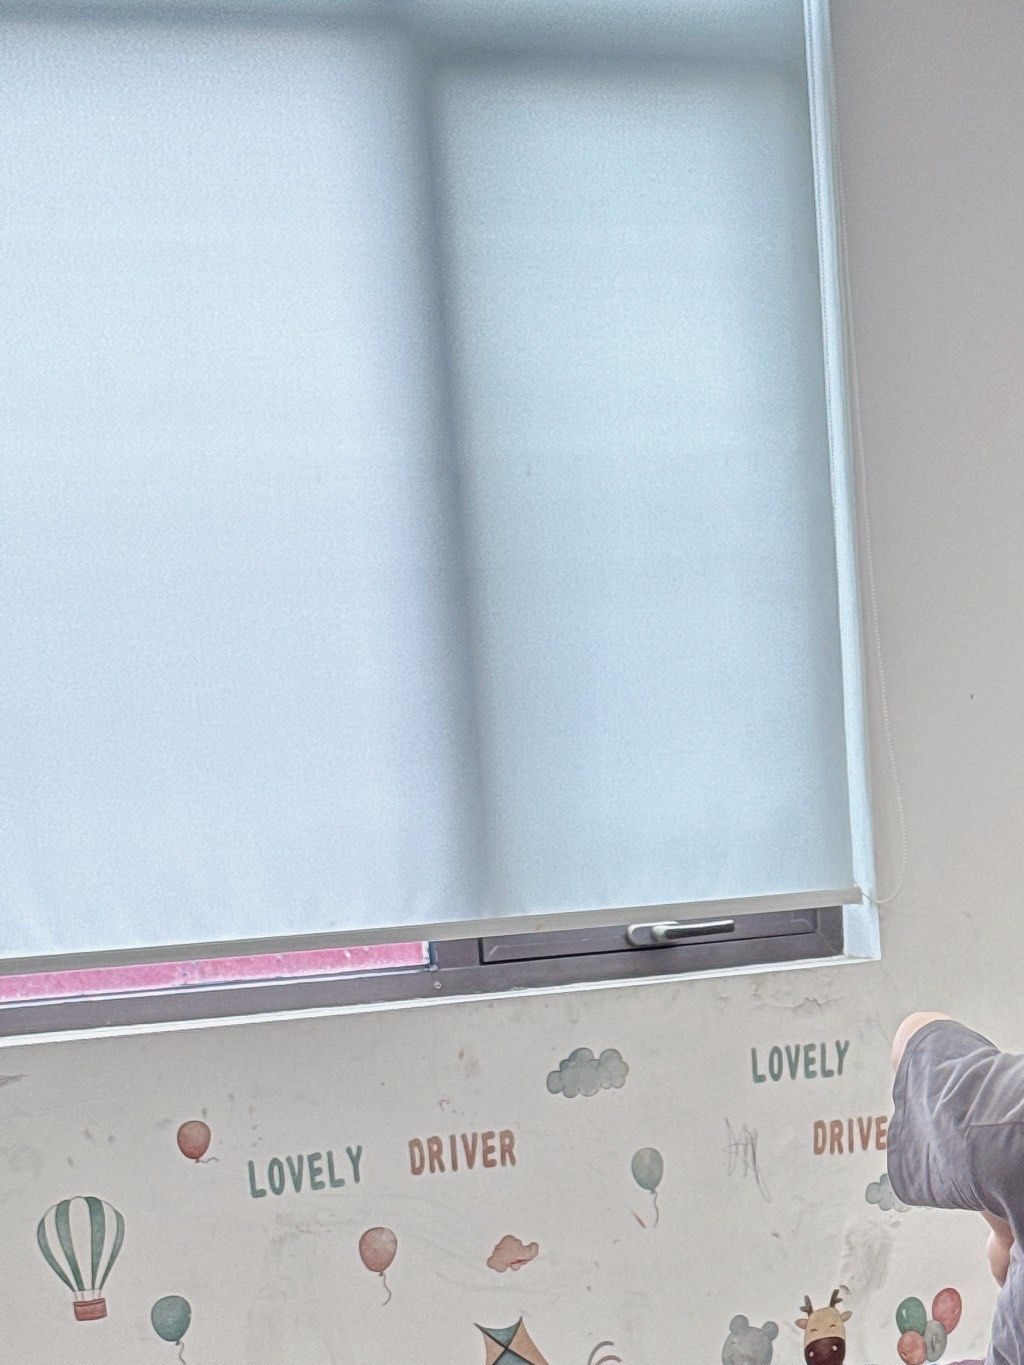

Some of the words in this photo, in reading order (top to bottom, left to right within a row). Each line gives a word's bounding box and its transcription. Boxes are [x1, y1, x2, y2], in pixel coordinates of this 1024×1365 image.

[751, 1040, 849, 1083] LOVELY
[813, 1115, 888, 1155] DRIVE
[248, 1145, 363, 1198] LOVELY
[408, 1129, 517, 1175] DRIVER
